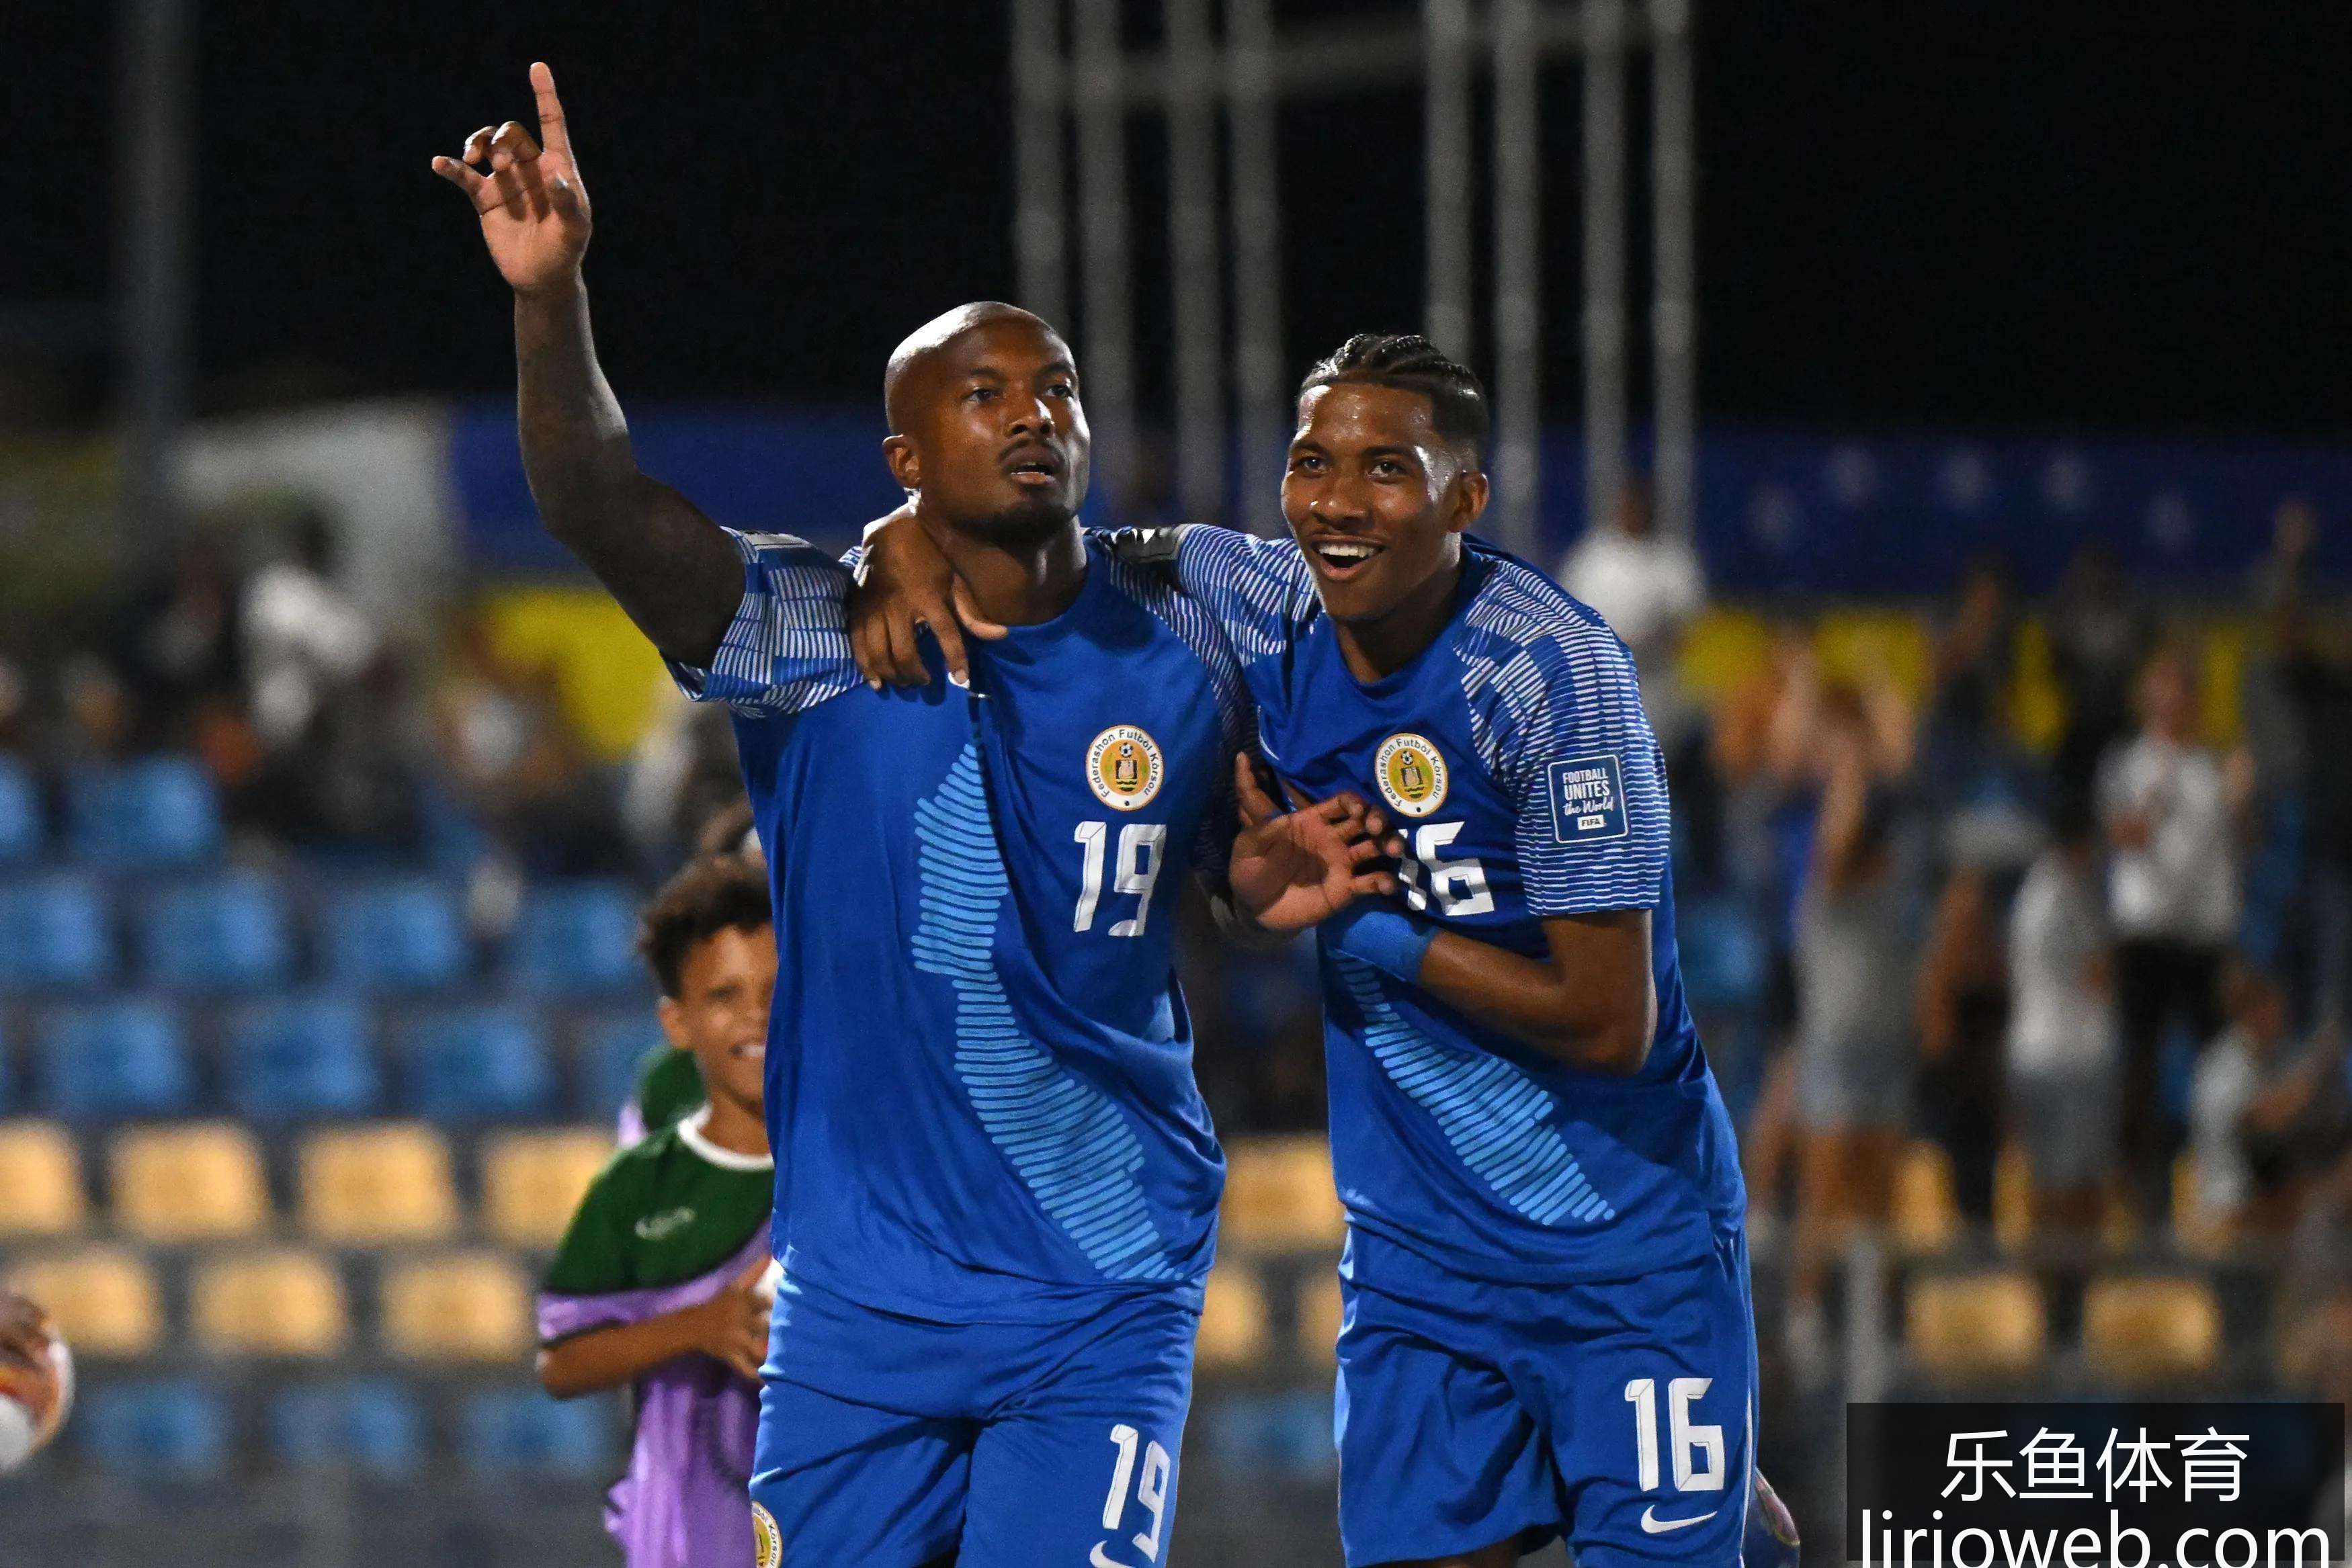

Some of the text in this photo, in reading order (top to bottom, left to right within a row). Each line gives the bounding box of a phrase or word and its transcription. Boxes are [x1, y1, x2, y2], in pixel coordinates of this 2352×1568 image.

[1092, 734, 1116, 797] Federashon
[1380, 744, 1402, 807] Federashon
[1562, 768, 1609, 784] FOOTBALL
[1564, 780, 1611, 801] UNITES
[1562, 796, 1614, 816] the World
[1581, 818, 1601, 827] FIFA
[1074, 821, 1167, 937] 19
[1624, 1377, 1725, 1491] 16
[1102, 1424, 1171, 1563] 19
